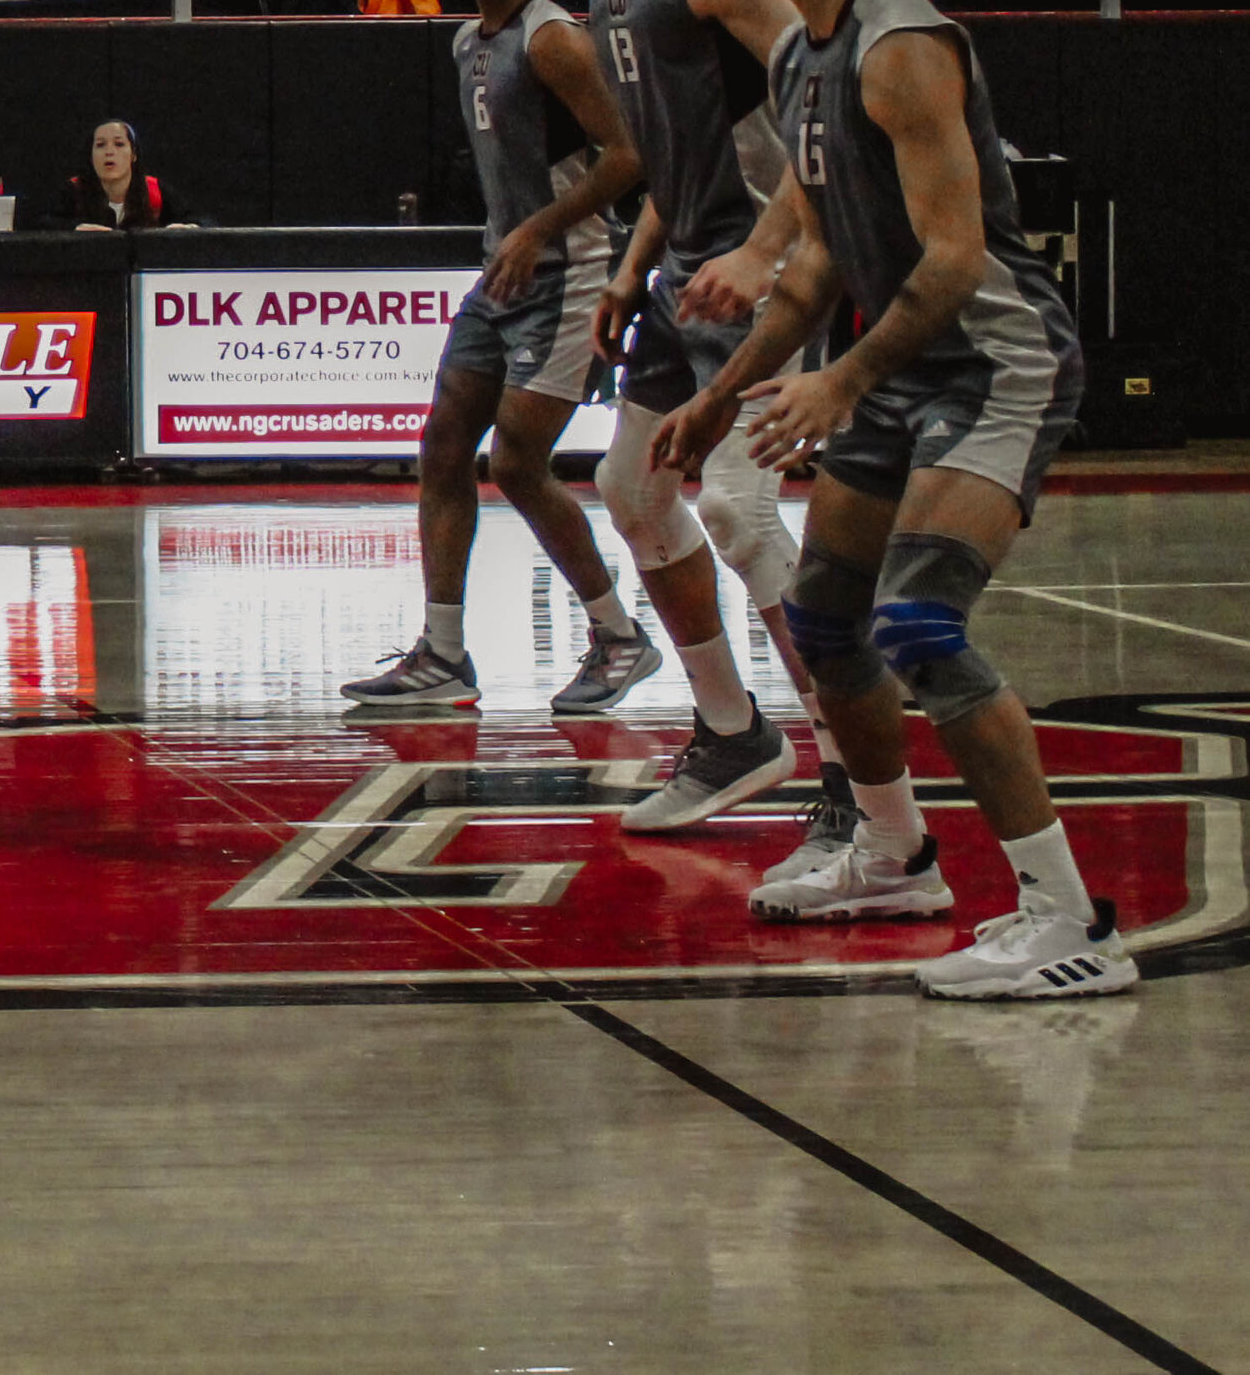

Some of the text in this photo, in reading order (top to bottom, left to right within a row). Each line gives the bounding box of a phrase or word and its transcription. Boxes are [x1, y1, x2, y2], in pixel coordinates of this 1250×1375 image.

[609, 28, 640, 82] 13
[474, 86, 491, 130] 6
[154, 291, 453, 326] DLK APPAREL
[217, 341, 401, 360] 704-674-5770
